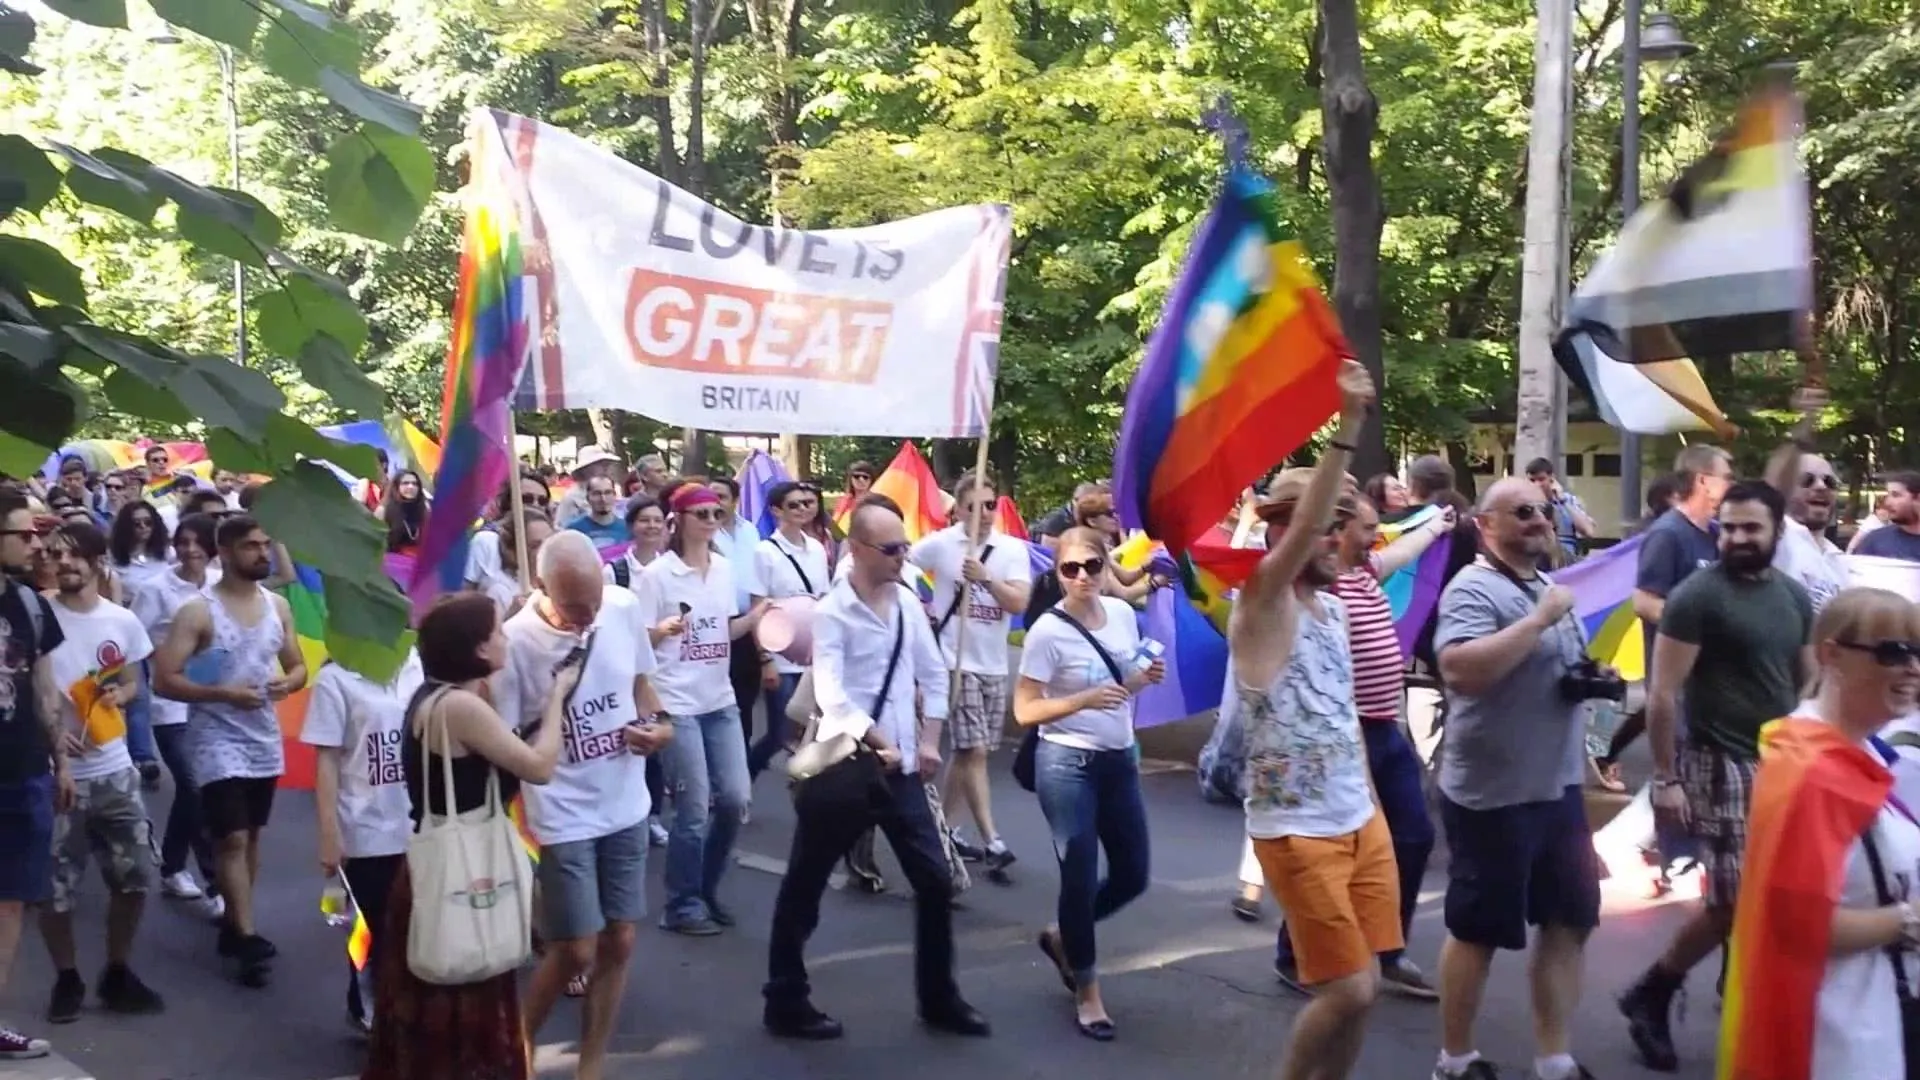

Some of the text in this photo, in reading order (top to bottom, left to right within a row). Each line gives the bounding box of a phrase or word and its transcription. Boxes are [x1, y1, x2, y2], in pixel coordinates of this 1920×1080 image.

[649, 180, 905, 281] LOVE IS
[633, 285, 891, 376] GREAT
[702, 384, 800, 414] BRITAIN
[690, 644, 728, 660] GREAT
[571, 692, 620, 721] LOVE
[380, 729, 402, 746] LO
[576, 720, 594, 737] IS
[382, 746, 396, 763] IS
[583, 731, 624, 758] GRE
